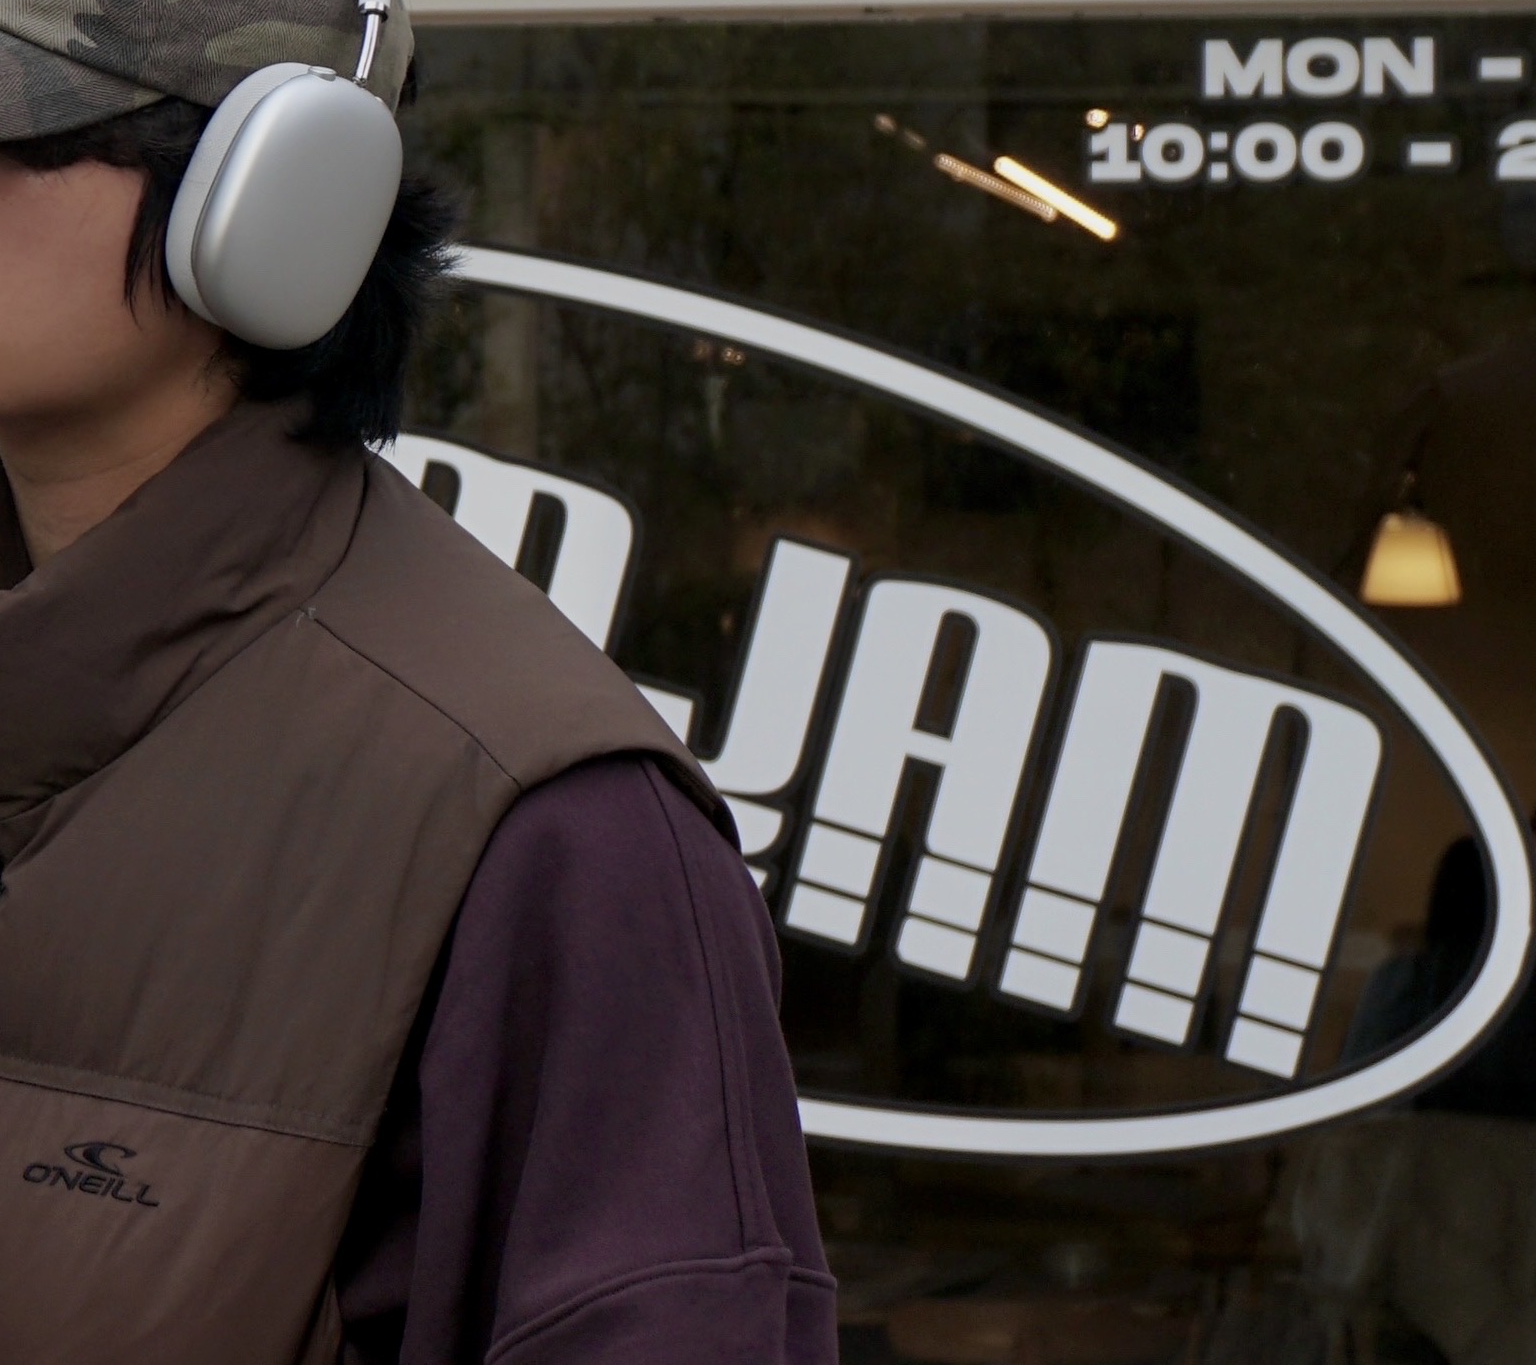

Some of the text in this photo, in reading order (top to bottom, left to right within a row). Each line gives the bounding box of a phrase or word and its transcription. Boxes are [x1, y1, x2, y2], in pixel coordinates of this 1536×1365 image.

[1204, 37, 1524, 98] MON -
[1089, 121, 1365, 184] 10:00
[1409, 142, 1453, 166] -
